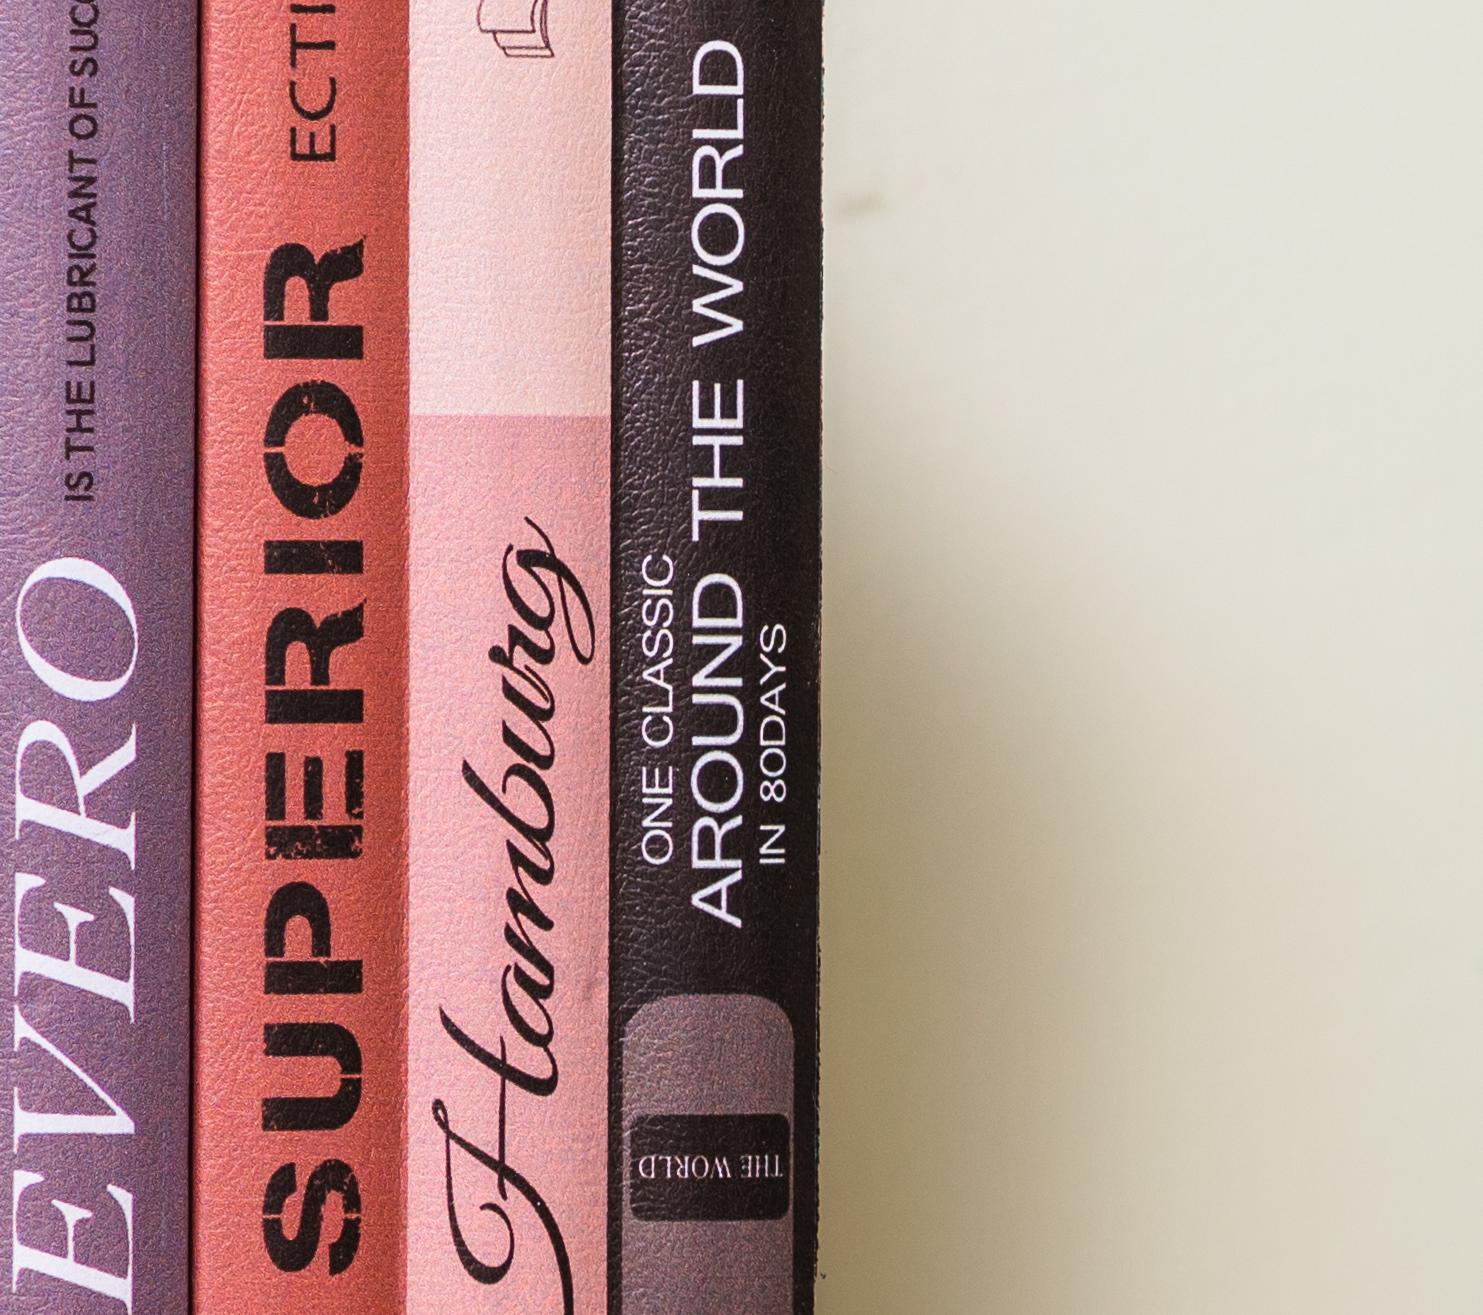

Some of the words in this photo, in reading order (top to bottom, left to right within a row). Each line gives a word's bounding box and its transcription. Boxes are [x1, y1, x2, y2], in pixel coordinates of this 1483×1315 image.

[69, 87, 98, 140] OF
[67, 150, 98, 366] LUBRICANT
[692, 41, 744, 346] WORLD
[65, 381, 95, 460] THE
[692, 380, 743, 541] THE
[65, 471, 93, 501] IS
[641, 555, 673, 747] CLASSIC
[760, 624, 786, 802] 80DAYS
[262, 239, 367, 1276] SUPERIOR
[691, 574, 743, 927] AROUND
[641, 767, 673, 864] ONE
[760, 825, 785, 864] IN
[638, 1154, 732, 1179] WORLD
[738, 1154, 784, 1179] THE
